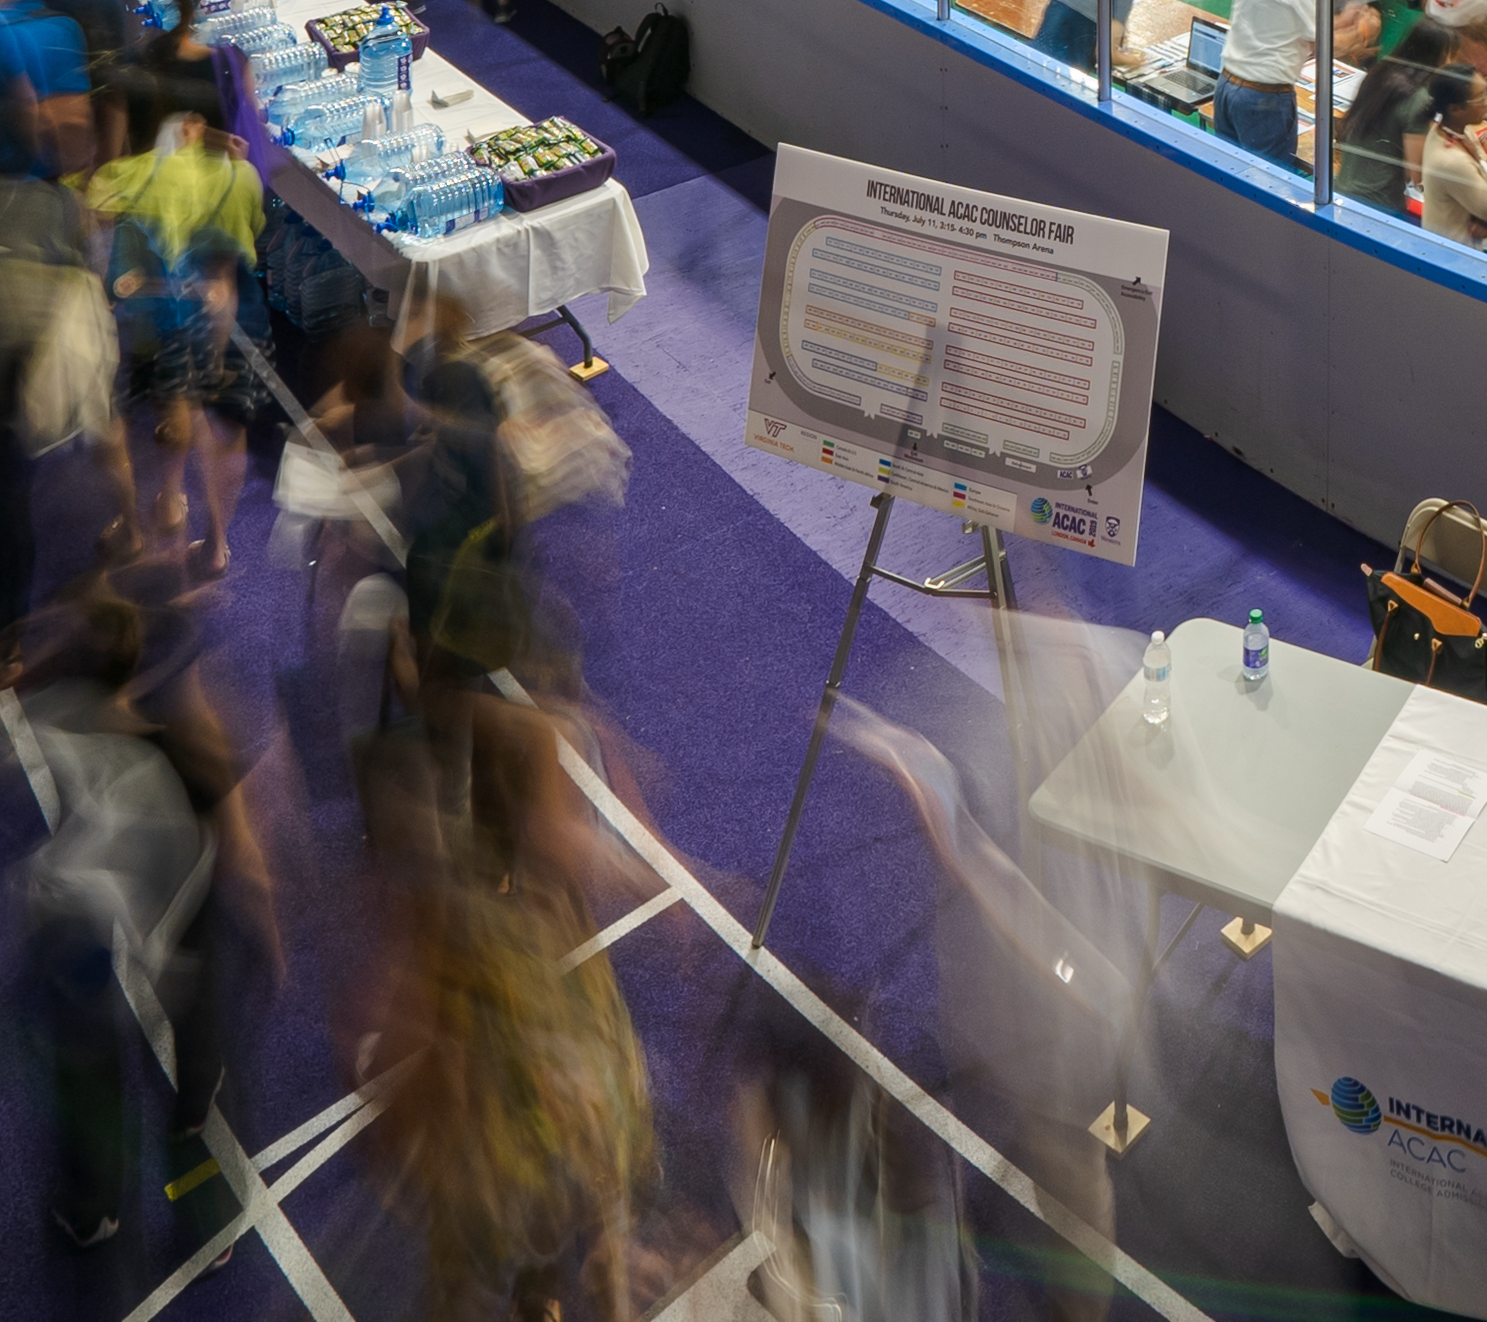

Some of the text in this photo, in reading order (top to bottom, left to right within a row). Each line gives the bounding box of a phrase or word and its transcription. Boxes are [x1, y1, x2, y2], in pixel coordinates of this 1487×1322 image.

[866, 179, 1075, 245] INTERNATIONAL ACAC COUNSELOR FAIR
[880, 206, 911, 223] Thursday,
[912, 214, 926, 226] July
[928, 219, 938, 229] 11,
[958, 226, 974, 236] 4:30
[975, 231, 987, 240] pm
[993, 234, 1030, 250] Thompson
[1032, 243, 1054, 254] Arena
[764, 418, 787, 438] VT
[753, 433, 794, 452] VIRGINIA TECH
[1052, 511, 1086, 535] ACAC
[1055, 502, 1098, 519] INTERNATIONAL
[1387, 1128, 1466, 1174] ACAC
[1389, 1159, 1468, 1192] INTERNATIONAL
[1389, 1169, 1433, 1196] COLLEGE
